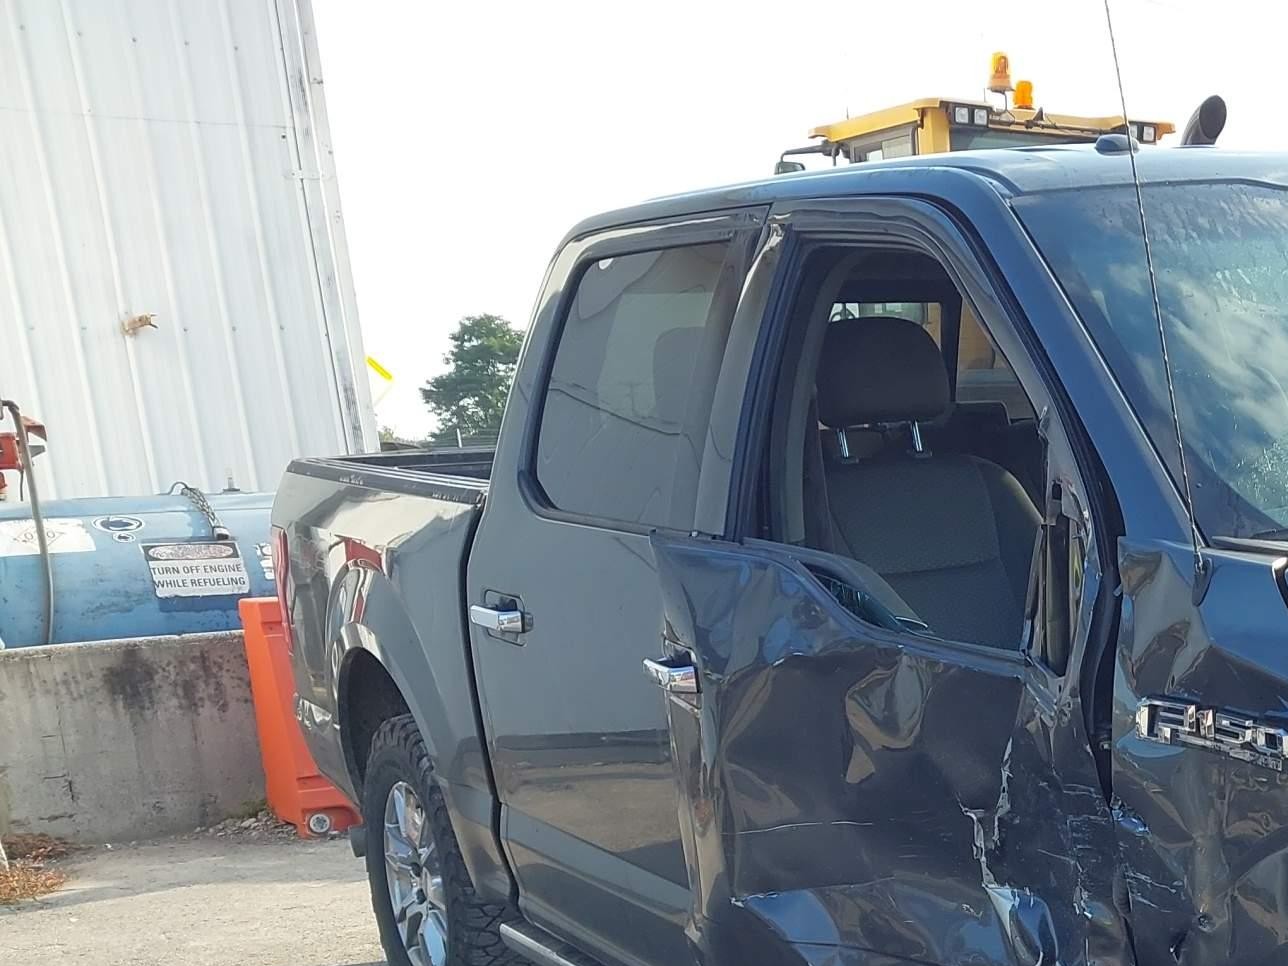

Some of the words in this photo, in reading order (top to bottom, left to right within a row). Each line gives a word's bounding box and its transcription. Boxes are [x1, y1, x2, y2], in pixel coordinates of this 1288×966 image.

[151, 565, 180, 576] TURN
[182, 564, 201, 575] OFF
[203, 563, 243, 574] ENGINE
[155, 578, 189, 589] WHILE
[190, 576, 246, 588] REFUELING
